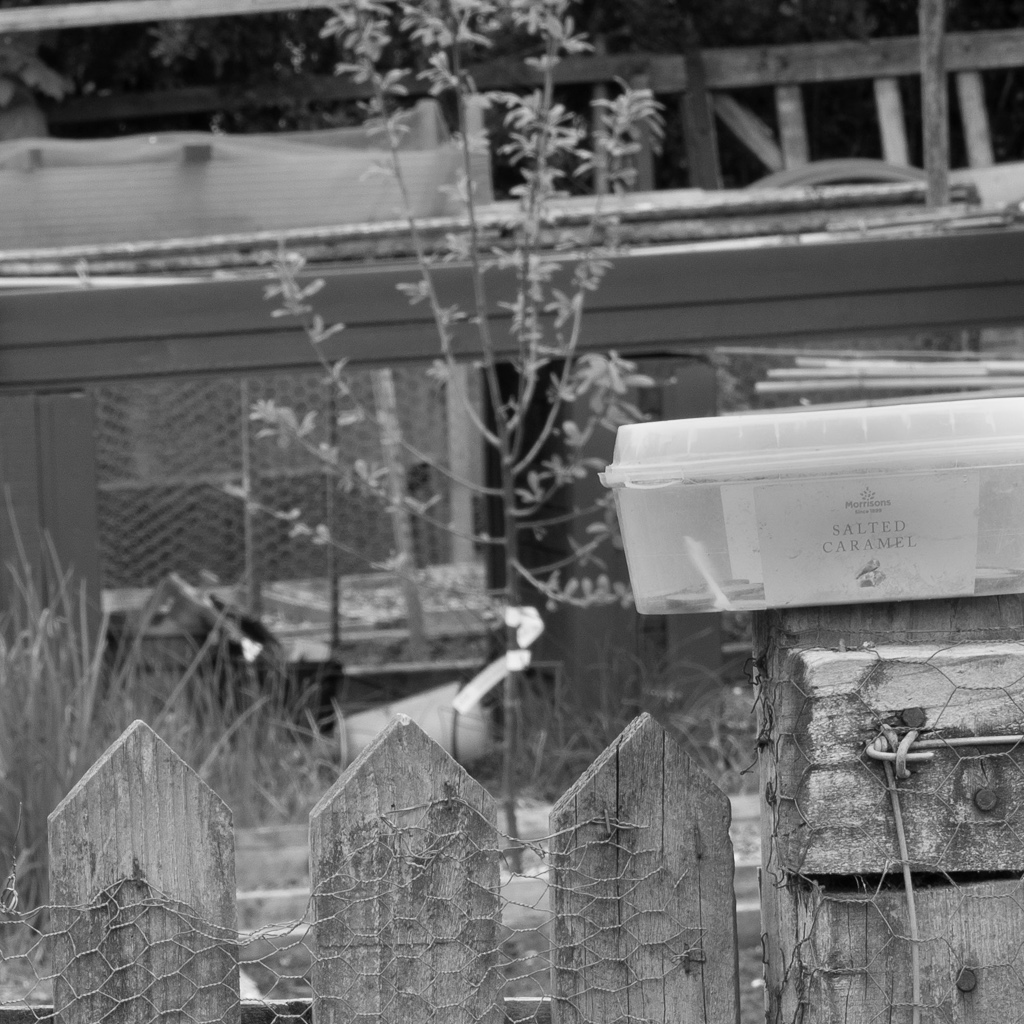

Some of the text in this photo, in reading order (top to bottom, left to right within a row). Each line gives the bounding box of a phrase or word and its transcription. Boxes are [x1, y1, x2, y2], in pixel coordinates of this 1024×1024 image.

[845, 500, 891, 509] Morrisons
[832, 520, 906, 536] SALTED
[822, 536, 917, 553] CARAMEL
